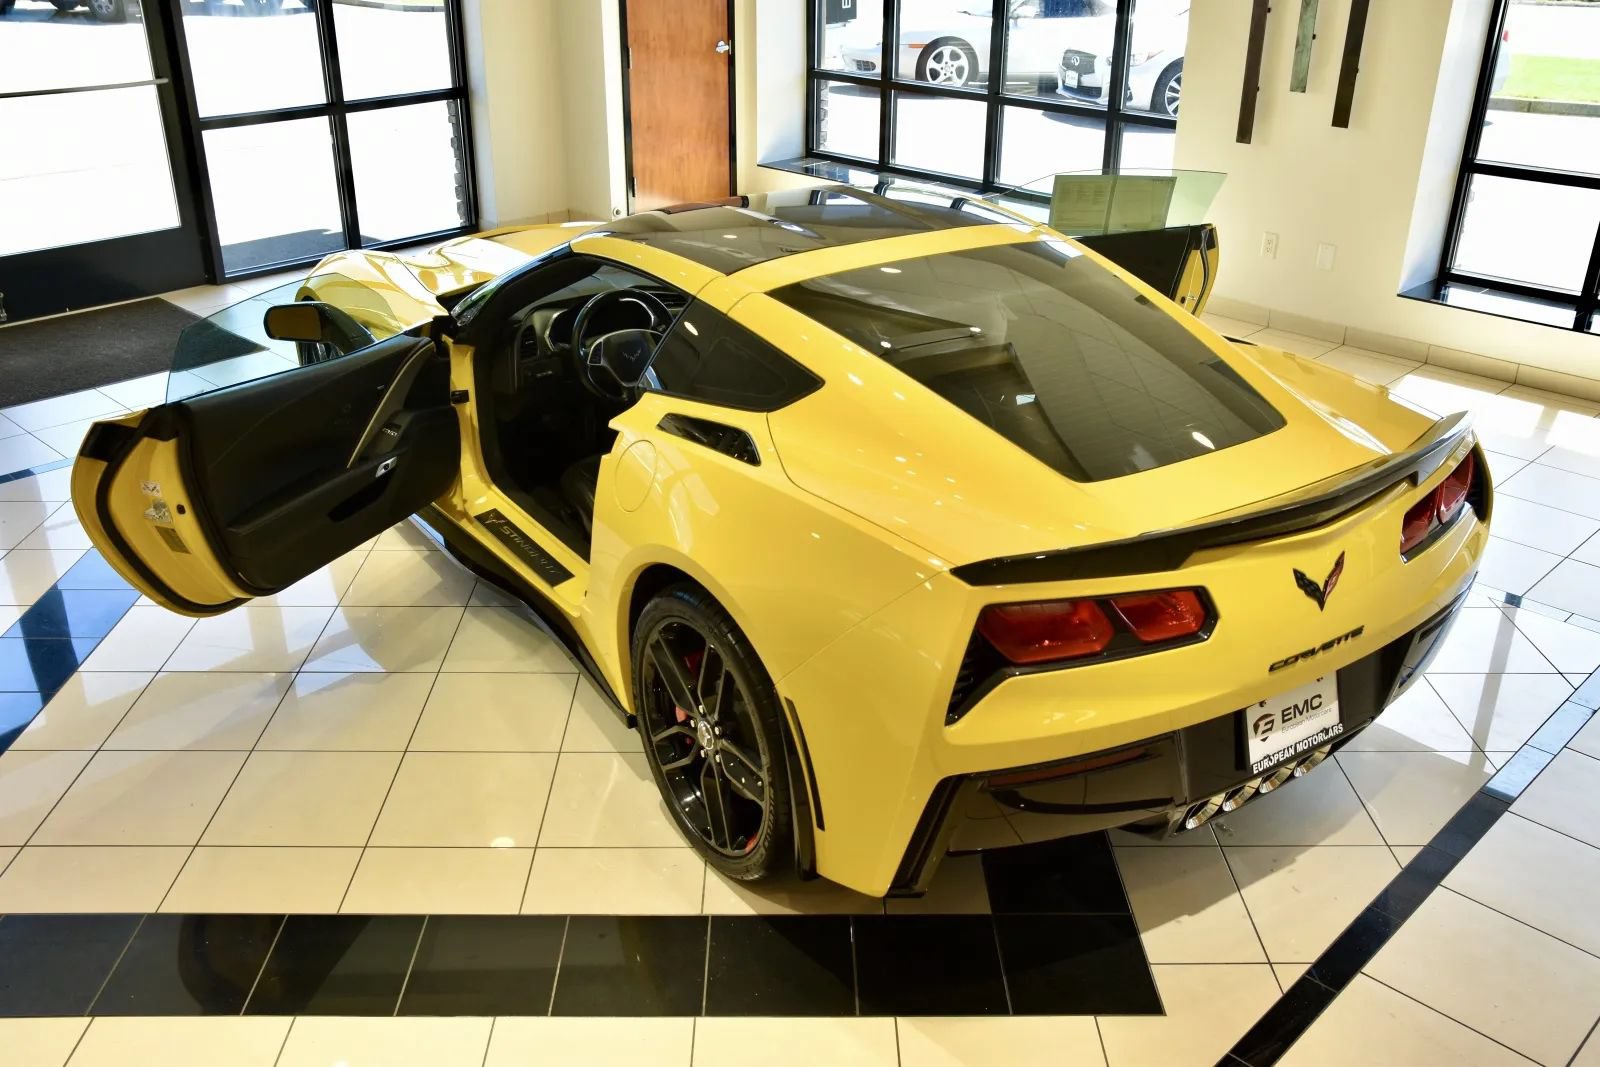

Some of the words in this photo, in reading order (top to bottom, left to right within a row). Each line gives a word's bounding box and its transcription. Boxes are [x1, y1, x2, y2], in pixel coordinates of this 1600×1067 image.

[500, 525, 561, 574] STING
[1268, 625, 1365, 672] CORVETTE
[1281, 694, 1323, 724] EMC
[1252, 744, 1295, 774] EUROPEAN
[1296, 723, 1344, 752] MOTORCARS
